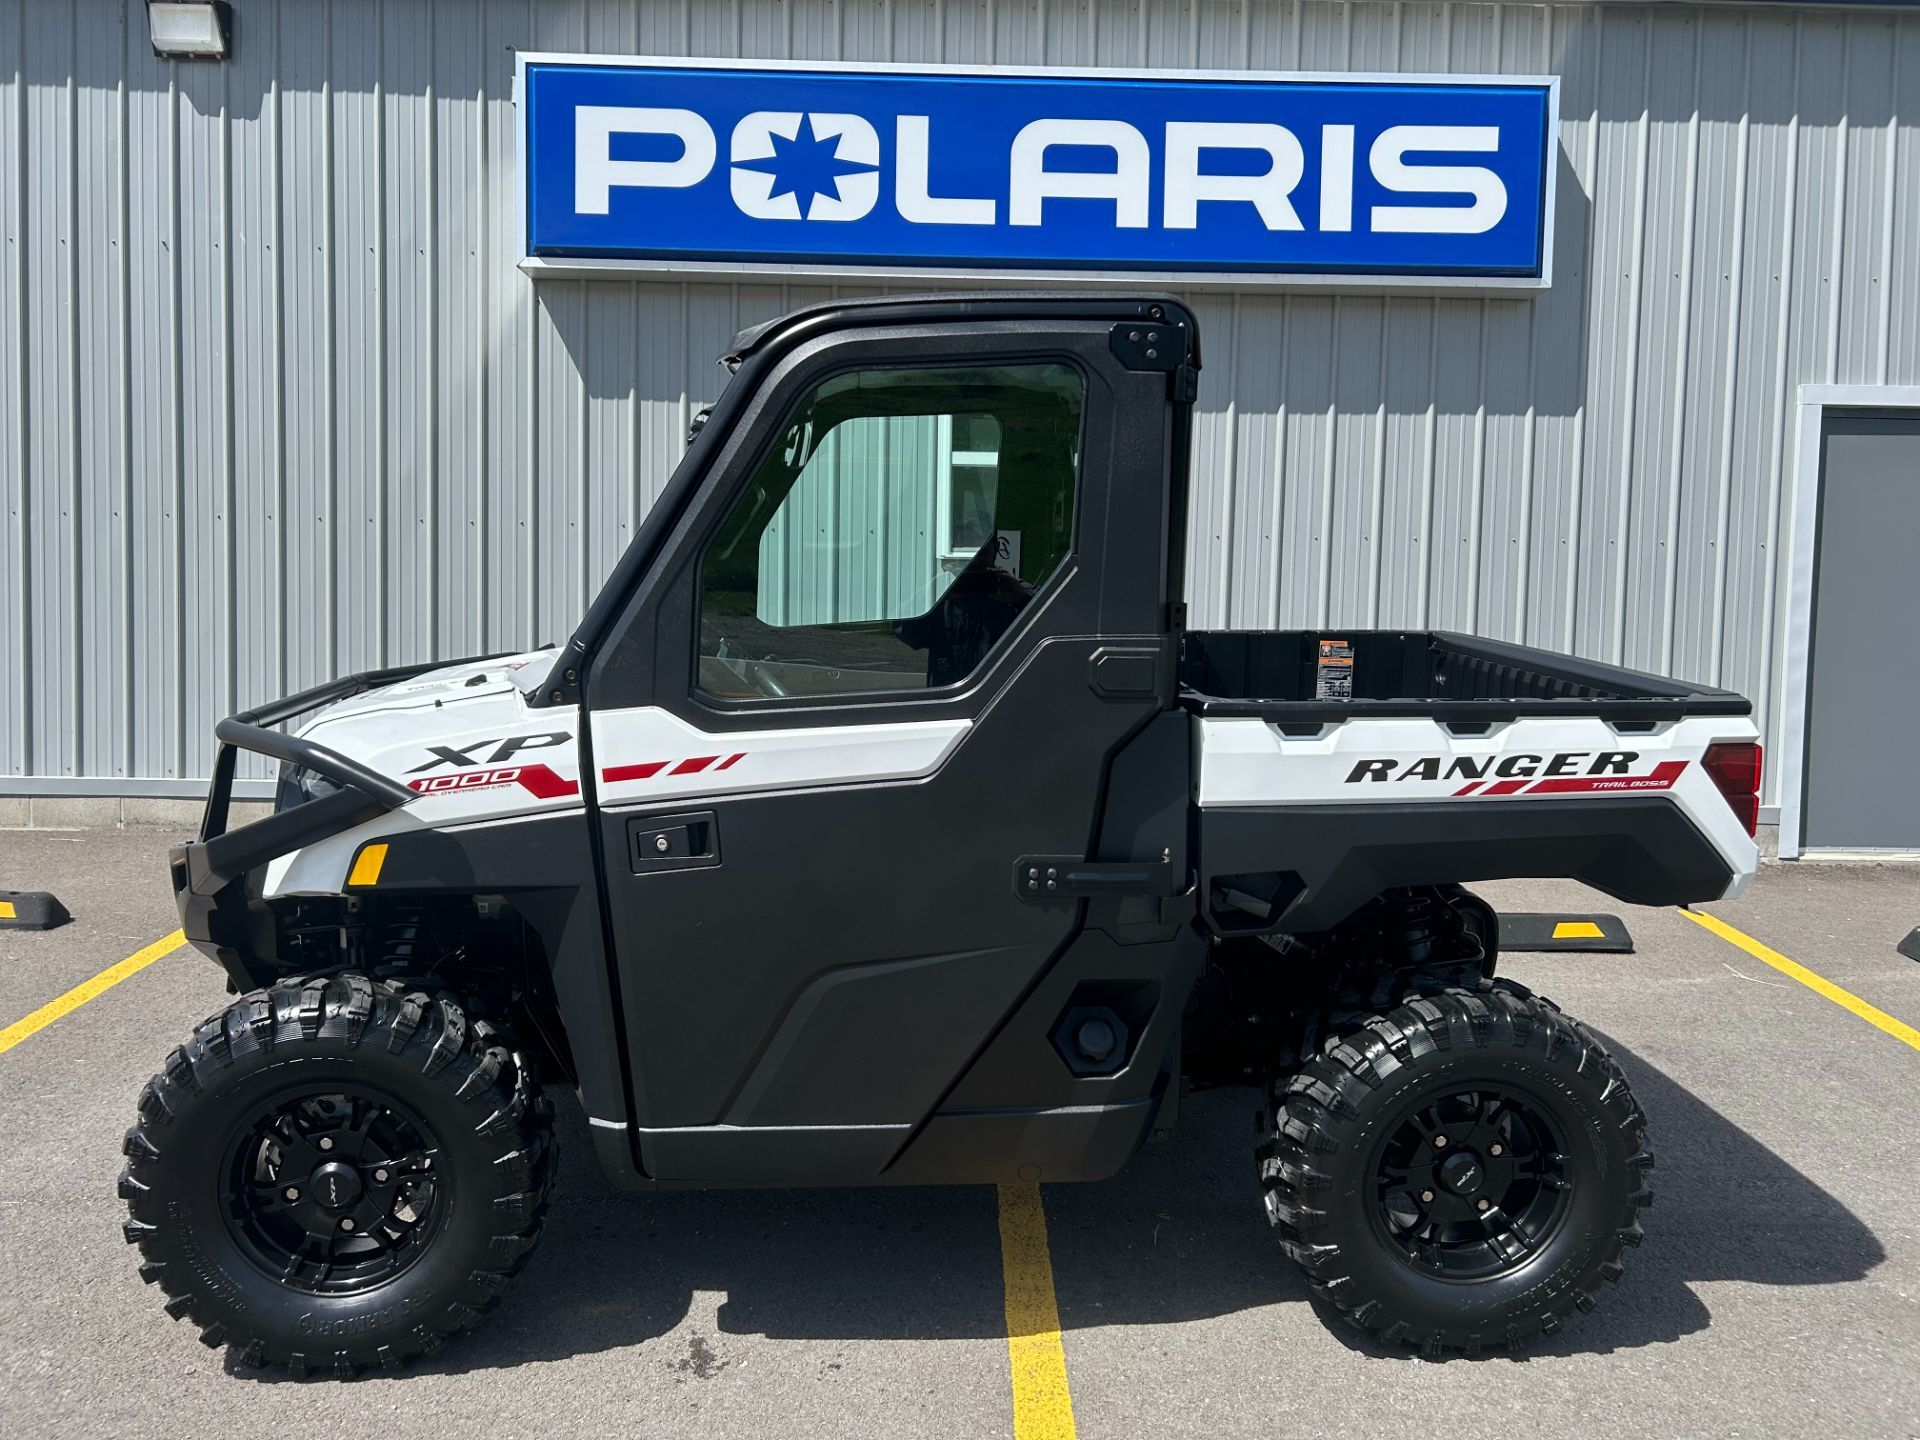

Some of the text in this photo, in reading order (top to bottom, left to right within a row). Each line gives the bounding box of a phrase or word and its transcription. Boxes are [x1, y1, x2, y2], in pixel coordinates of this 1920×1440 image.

[575, 105, 1507, 234] POLARIS
[402, 731, 574, 774] XP
[1344, 751, 1640, 783] RANGER
[418, 768, 522, 791] 1000
[1592, 781, 1629, 789] TRAIL
